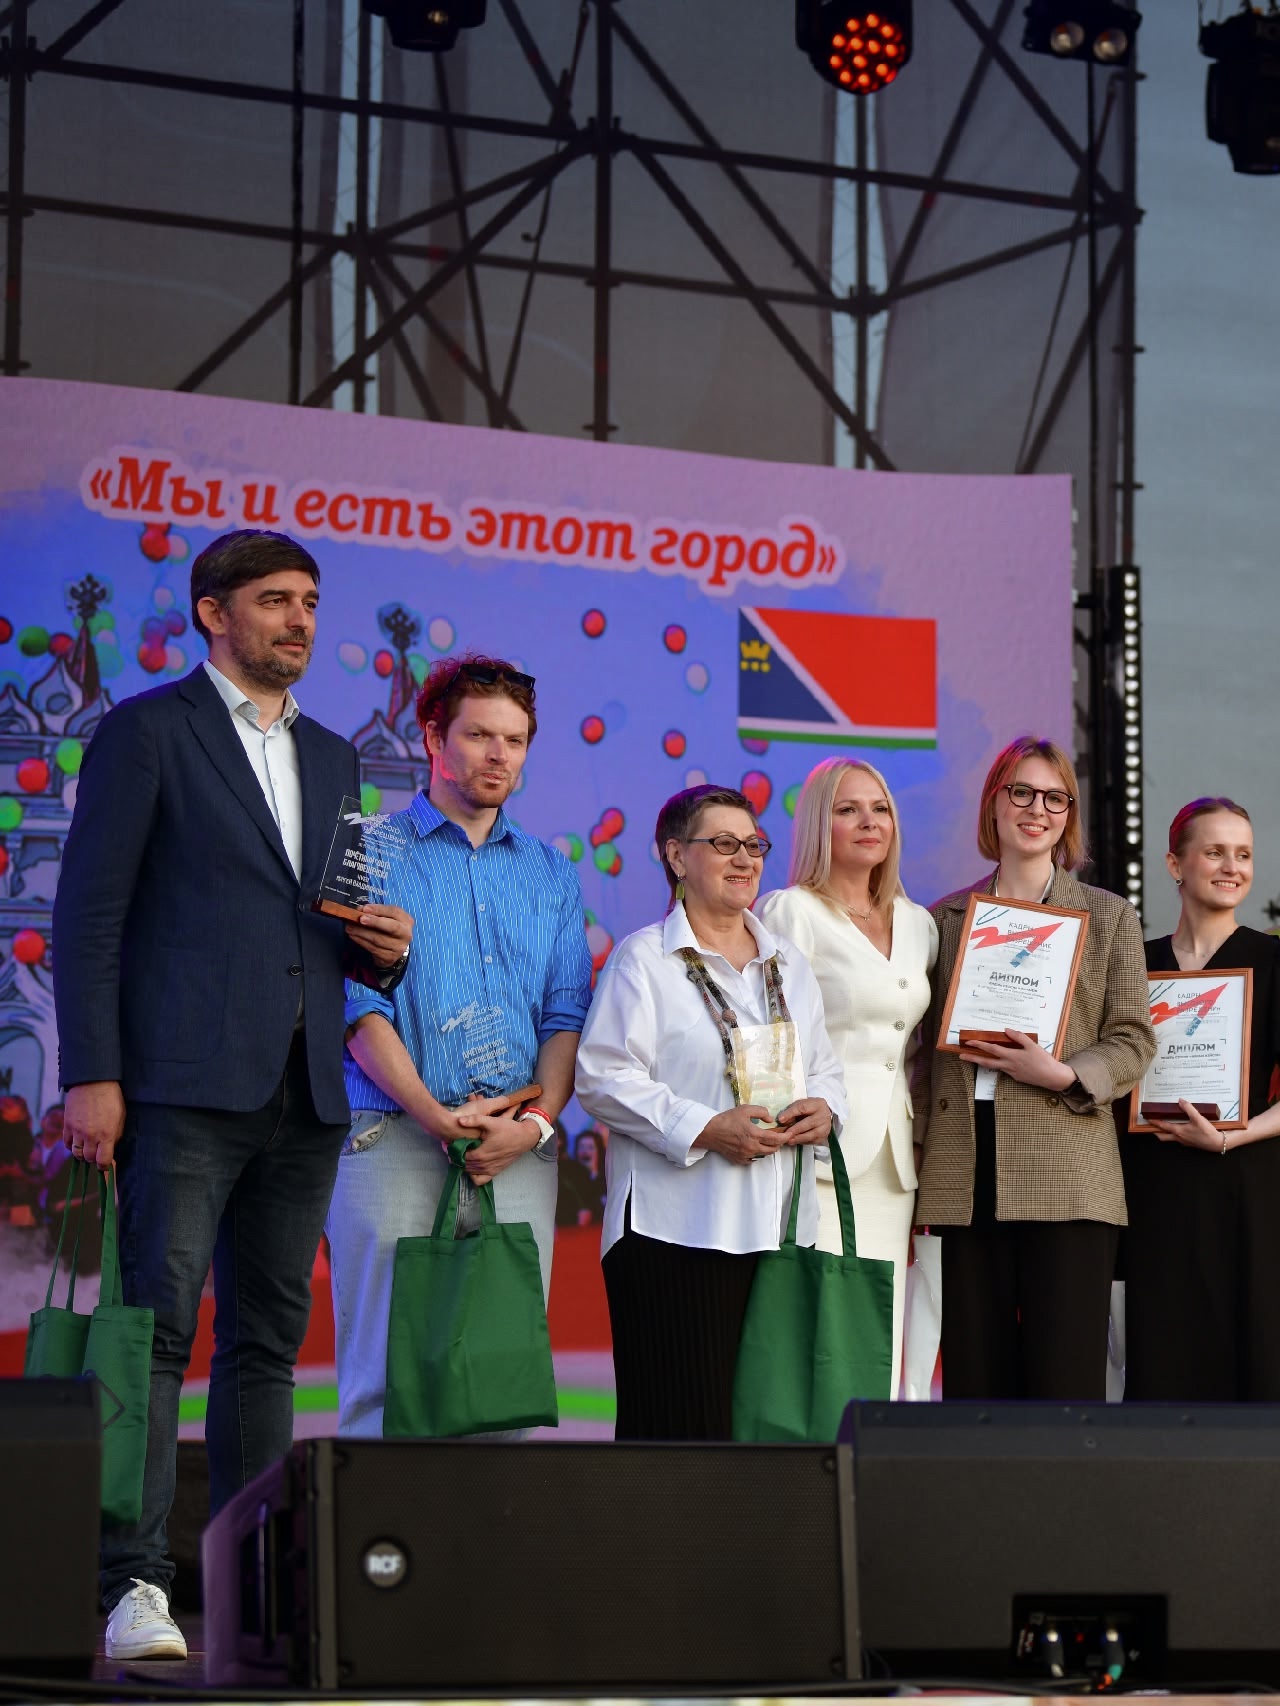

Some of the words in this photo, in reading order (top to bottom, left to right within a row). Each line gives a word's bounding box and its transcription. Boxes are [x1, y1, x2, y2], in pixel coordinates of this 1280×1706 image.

[88, 456, 225, 519] «Мы
[242, 482, 280, 525] и
[294, 489, 452, 543] есть
[465, 507, 636, 562] этот
[650, 523, 836, 587] город»
[989, 971, 1039, 988] ДИПЛОМ
[1168, 1043, 1216, 1054] ДИПЛОМ
[368, 1554, 401, 1574] RCF
